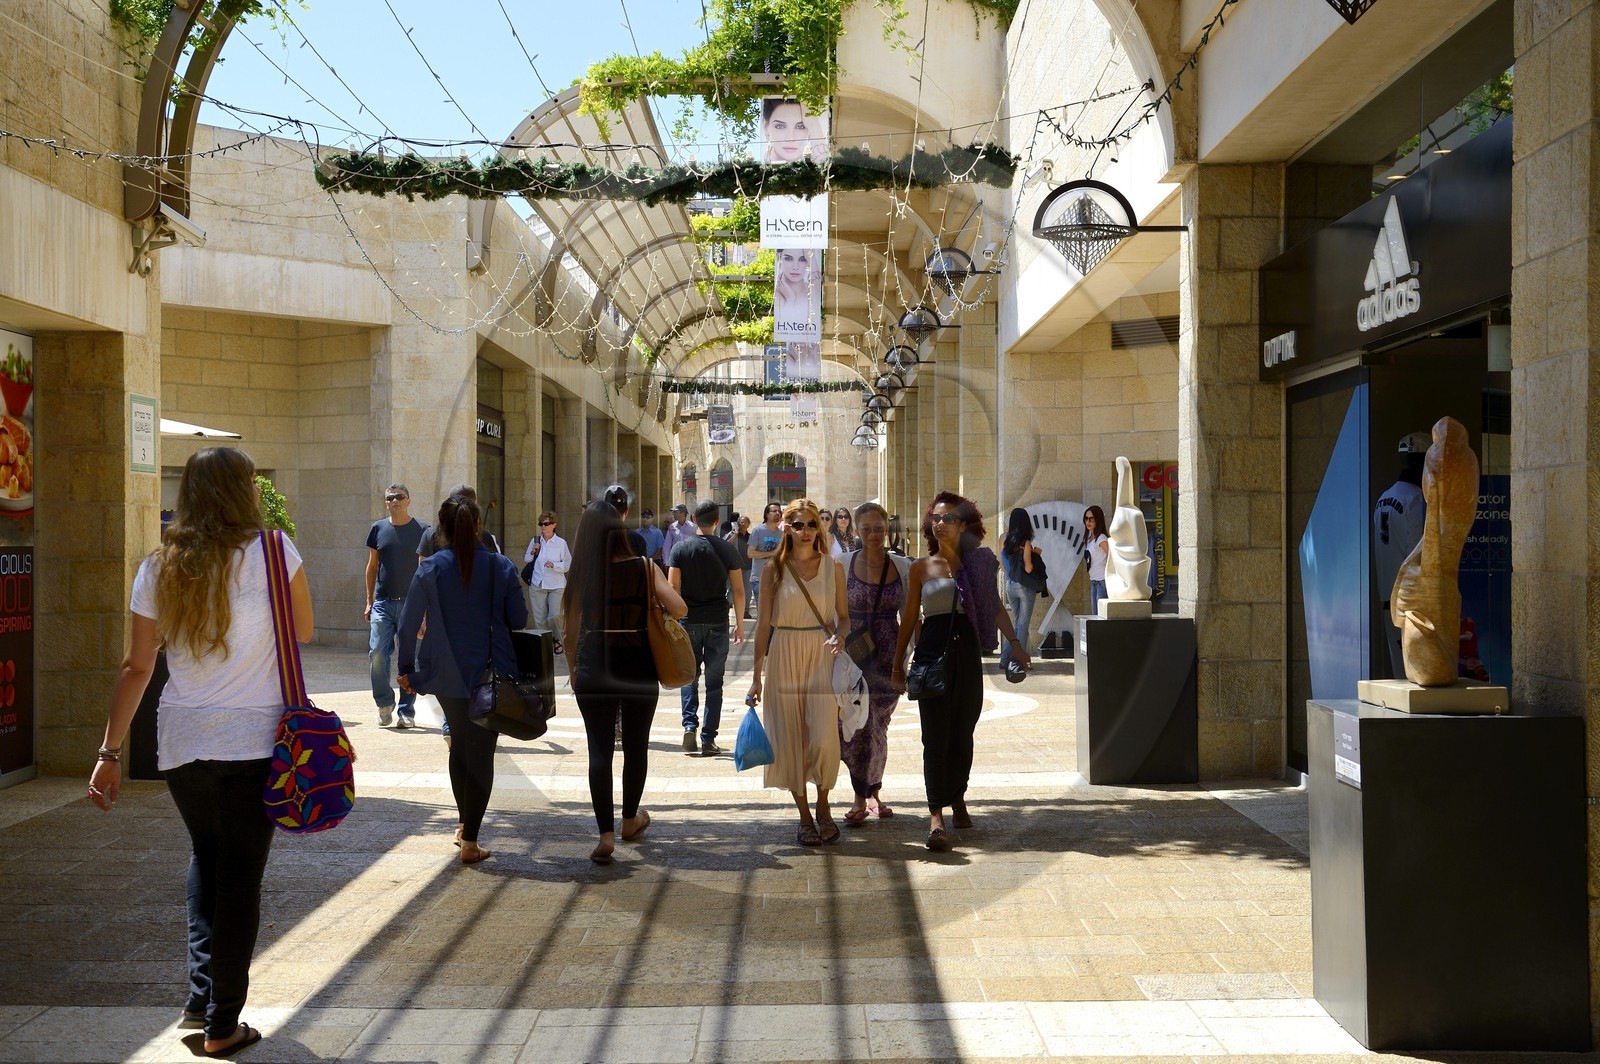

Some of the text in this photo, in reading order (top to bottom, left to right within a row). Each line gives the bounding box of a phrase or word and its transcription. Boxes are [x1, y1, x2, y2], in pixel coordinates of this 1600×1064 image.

[766, 218, 823, 232] H.Stern
[1357, 277, 1421, 332] adidas
[486, 422, 501, 438] CURL
[141, 448, 146, 461] 3
[1479, 535, 1509, 545] deadly
[1155, 505, 1166, 597] Vintage by color
